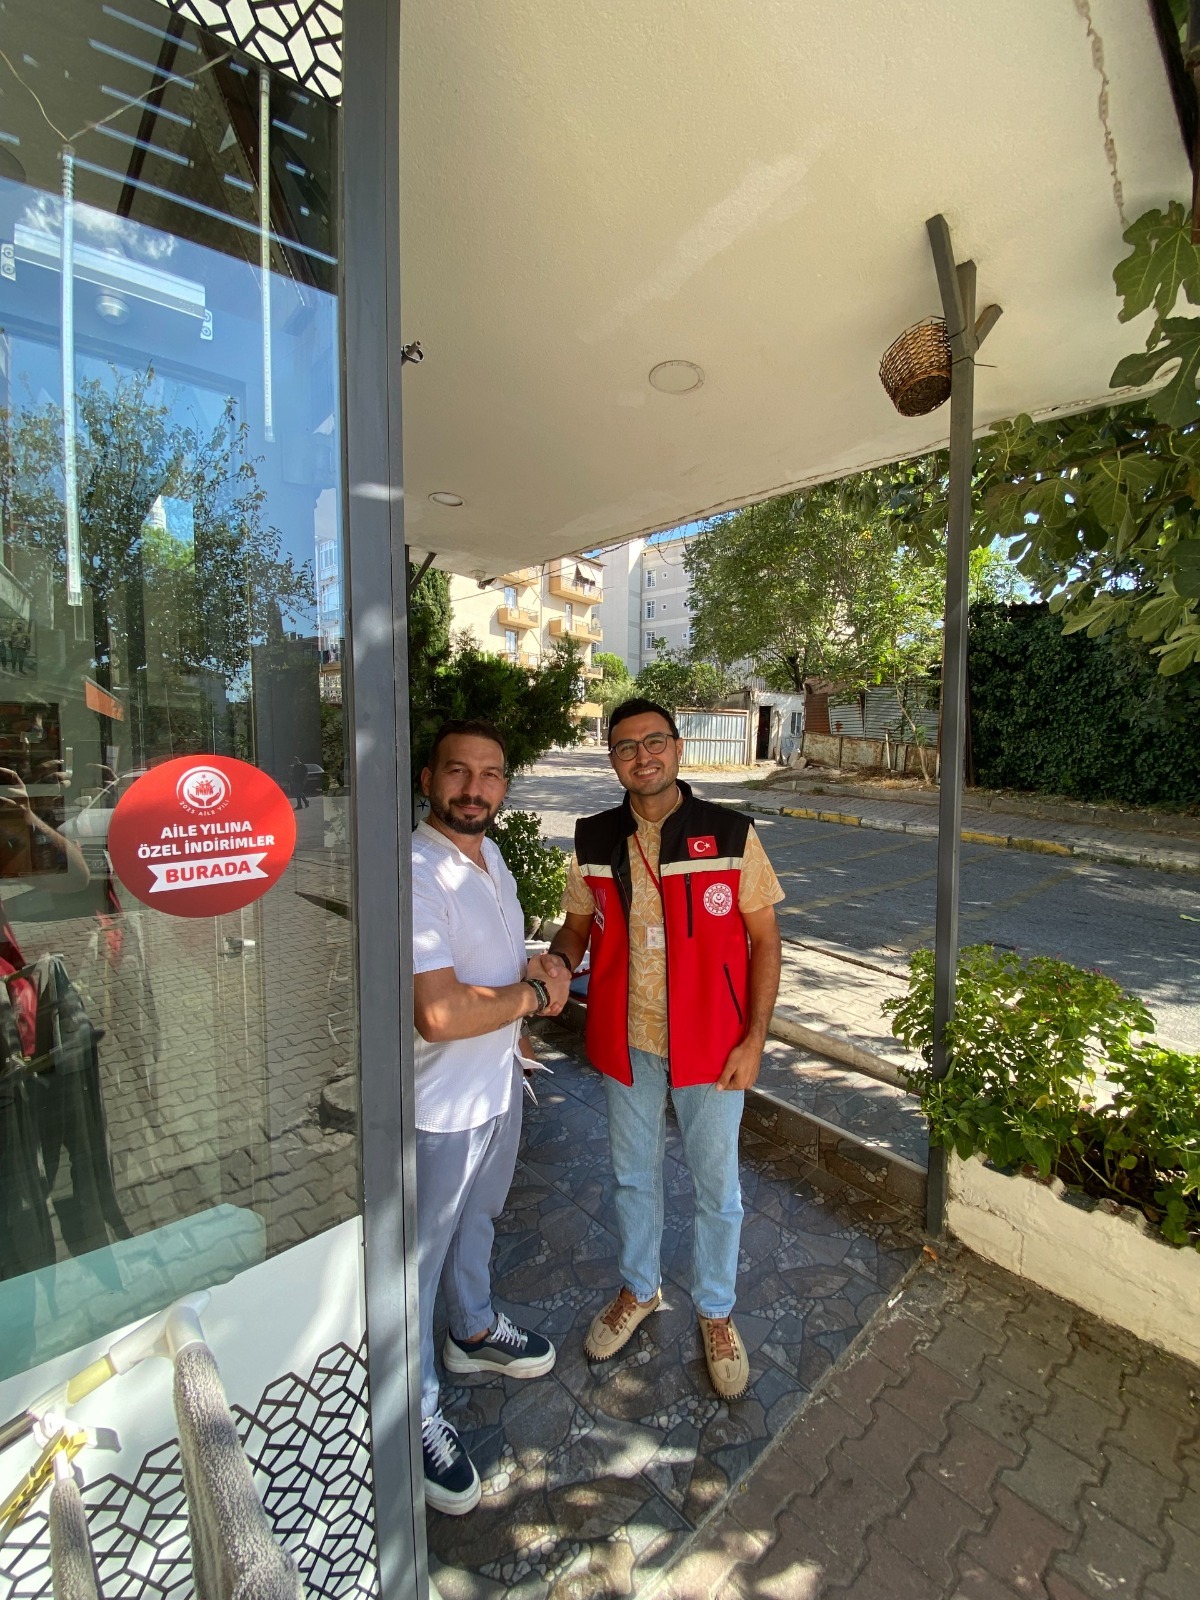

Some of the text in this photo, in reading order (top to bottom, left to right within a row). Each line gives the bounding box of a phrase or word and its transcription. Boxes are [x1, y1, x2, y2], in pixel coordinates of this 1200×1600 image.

[179, 800, 195, 814] 2025
[217, 799, 230, 811] YILI
[161, 820, 252, 839] AİLE YILINA
[137, 835, 275, 859] ÖZEL İNDİRİMLER
[165, 860, 251, 883] BURADA
